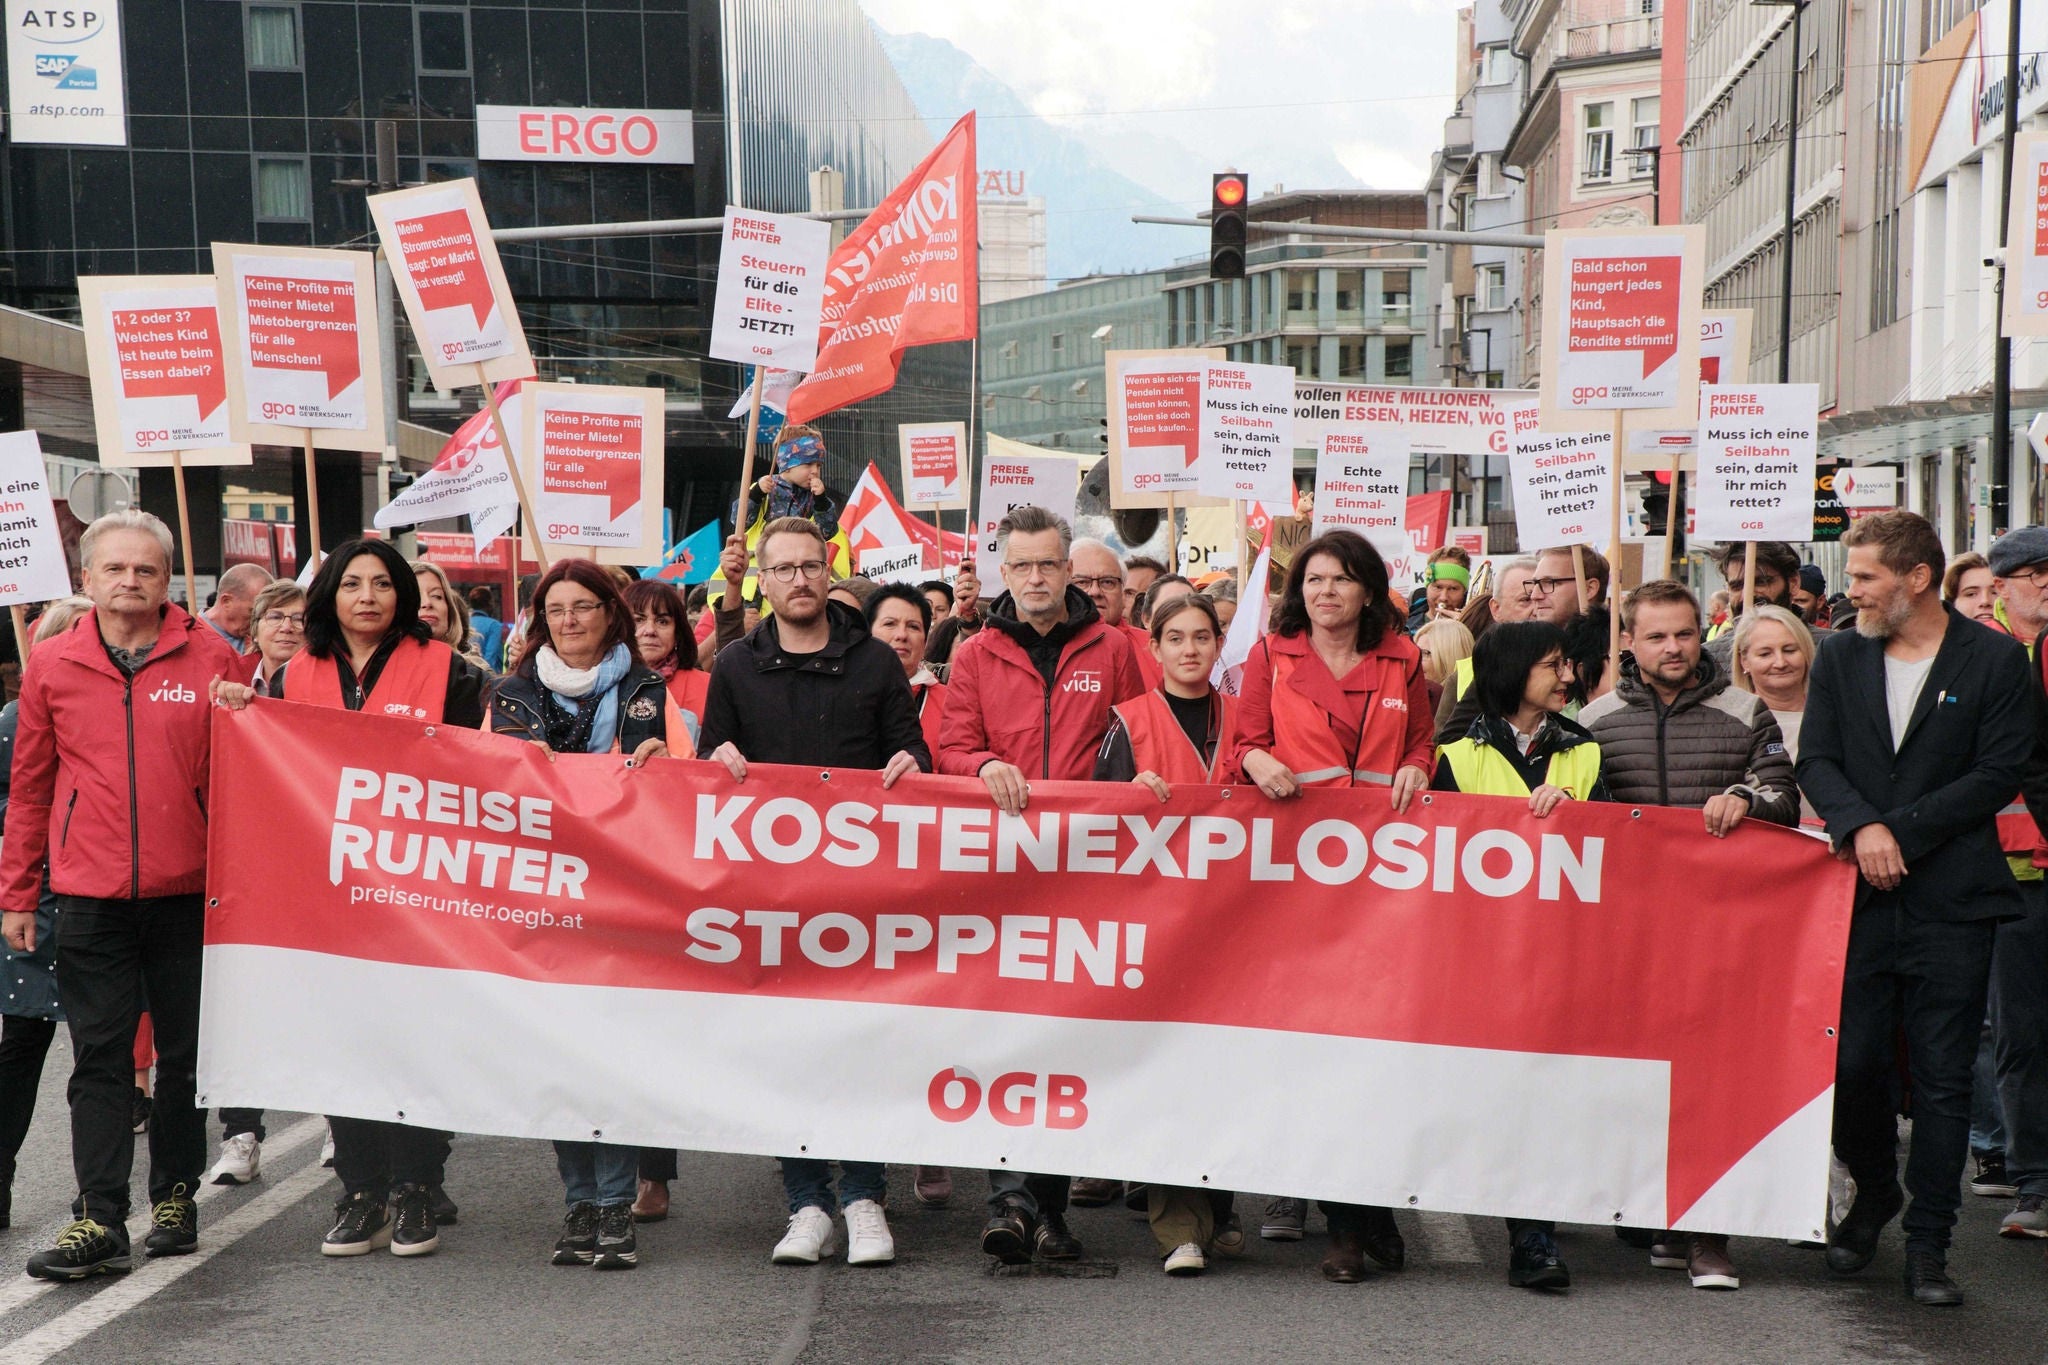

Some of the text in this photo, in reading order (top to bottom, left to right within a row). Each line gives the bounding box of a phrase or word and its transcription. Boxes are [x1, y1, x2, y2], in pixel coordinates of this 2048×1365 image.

[22, 10, 96, 28] ATSP
[37, 58, 69, 73] SAP
[30, 104, 104, 118] atsp.com
[518, 113, 658, 157] ERGO
[977, 170, 1024, 196] ÄU
[397, 223, 424, 235] Meine
[733, 218, 775, 232] PREISE
[403, 233, 472, 254] Stromrechnung
[732, 229, 781, 245] RUNTER
[408, 251, 475, 273] sagt: Der Markt
[741, 255, 806, 276] Steuern
[1574, 261, 1647, 273] Bald schon
[247, 278, 354, 296] Keine Profite mit
[414, 271, 465, 289] hat versagt!
[745, 276, 798, 295] für die
[1573, 280, 1662, 294] hungert jedes
[249, 298, 334, 312] meiner Miete!
[746, 297, 782, 313] Elite
[1572, 299, 1605, 311] Kind,
[114, 311, 191, 327] 1, 2 oder 3?
[250, 314, 356, 332] Mietobergrenzen
[739, 317, 794, 336] JETZT!
[117, 329, 208, 343] Welches Kind
[251, 332, 295, 345] für alle
[1571, 334, 1673, 347] Rendite stimmt!
[120, 347, 213, 362] ist heute beim
[252, 351, 322, 365] Menschen!
[123, 365, 211, 380] Essen dabei?
[1208, 369, 1246, 379] PREISE
[1126, 376, 1150, 385] Wenn
[1152, 375, 1164, 383] sie
[1167, 375, 1184, 383] sich
[1208, 379, 1252, 390] RUNTER
[1126, 389, 1161, 397] Pendeln
[1346, 390, 1395, 403] KEINE
[1400, 391, 1495, 410] MILLIONEN,
[1573, 386, 1607, 404] gpa
[1711, 394, 1757, 405] PREISE
[262, 402, 295, 419] gpa
[1127, 400, 1190, 409] leisten können,
[1207, 399, 1288, 414] Muss ich eine
[1128, 413, 1154, 421] sollen
[1345, 407, 1404, 425] ESSEN,
[1409, 410, 1473, 426] HEIZEN,
[1711, 406, 1764, 419] RUNTER
[546, 413, 642, 428] Keine Profite mit
[1221, 415, 1273, 428] Seilbahn
[546, 430, 623, 443] meiner Miete!
[1128, 425, 1156, 434] Teslas
[1708, 428, 1809, 440] Muss ich eine
[136, 430, 169, 448] gpa
[1214, 431, 1280, 444] sein, damit
[1326, 435, 1363, 444] PREISE
[1517, 433, 1611, 455] Muss ich eine
[545, 445, 640, 460] Mietobergrenzen
[1222, 444, 1271, 457] ihr mich
[1326, 444, 1369, 455] RUNTER
[1725, 446, 1790, 456] Seilbahn
[545, 461, 584, 472] für alle
[1226, 461, 1267, 472] rettet?
[1535, 451, 1596, 468] Seilbahn
[991, 465, 1029, 474] PREISE
[1344, 466, 1382, 477] Echte
[1529, 465, 1606, 486] sein, damit
[1716, 463, 1798, 475] sein, damit
[7, 480, 39, 493] eine
[545, 477, 607, 490] Menschen!
[990, 476, 1034, 487] RUNTER
[1134, 473, 1161, 488] gpa
[1325, 481, 1399, 494] Hilfen statt
[1725, 479, 1787, 490] ihr mich
[1540, 483, 1598, 500] ihr mich
[1336, 498, 1385, 509] Einmal-
[1547, 500, 1595, 516] rettet?
[1730, 497, 1781, 508] rettet?
[1322, 514, 1396, 527] zahlungen!
[549, 524, 579, 539] gpa
[862, 553, 918, 578] Kaufkraft
[1062, 671, 1101, 692] vida
[149, 680, 196, 703] vida
[334, 766, 552, 840] PREISE
[693, 793, 1605, 903] KOSTENEXPLOSION
[329, 822, 589, 900] RUNTER
[350, 884, 583, 929] preiserunter.oegb.at
[684, 907, 1147, 990] STOPPEN!
